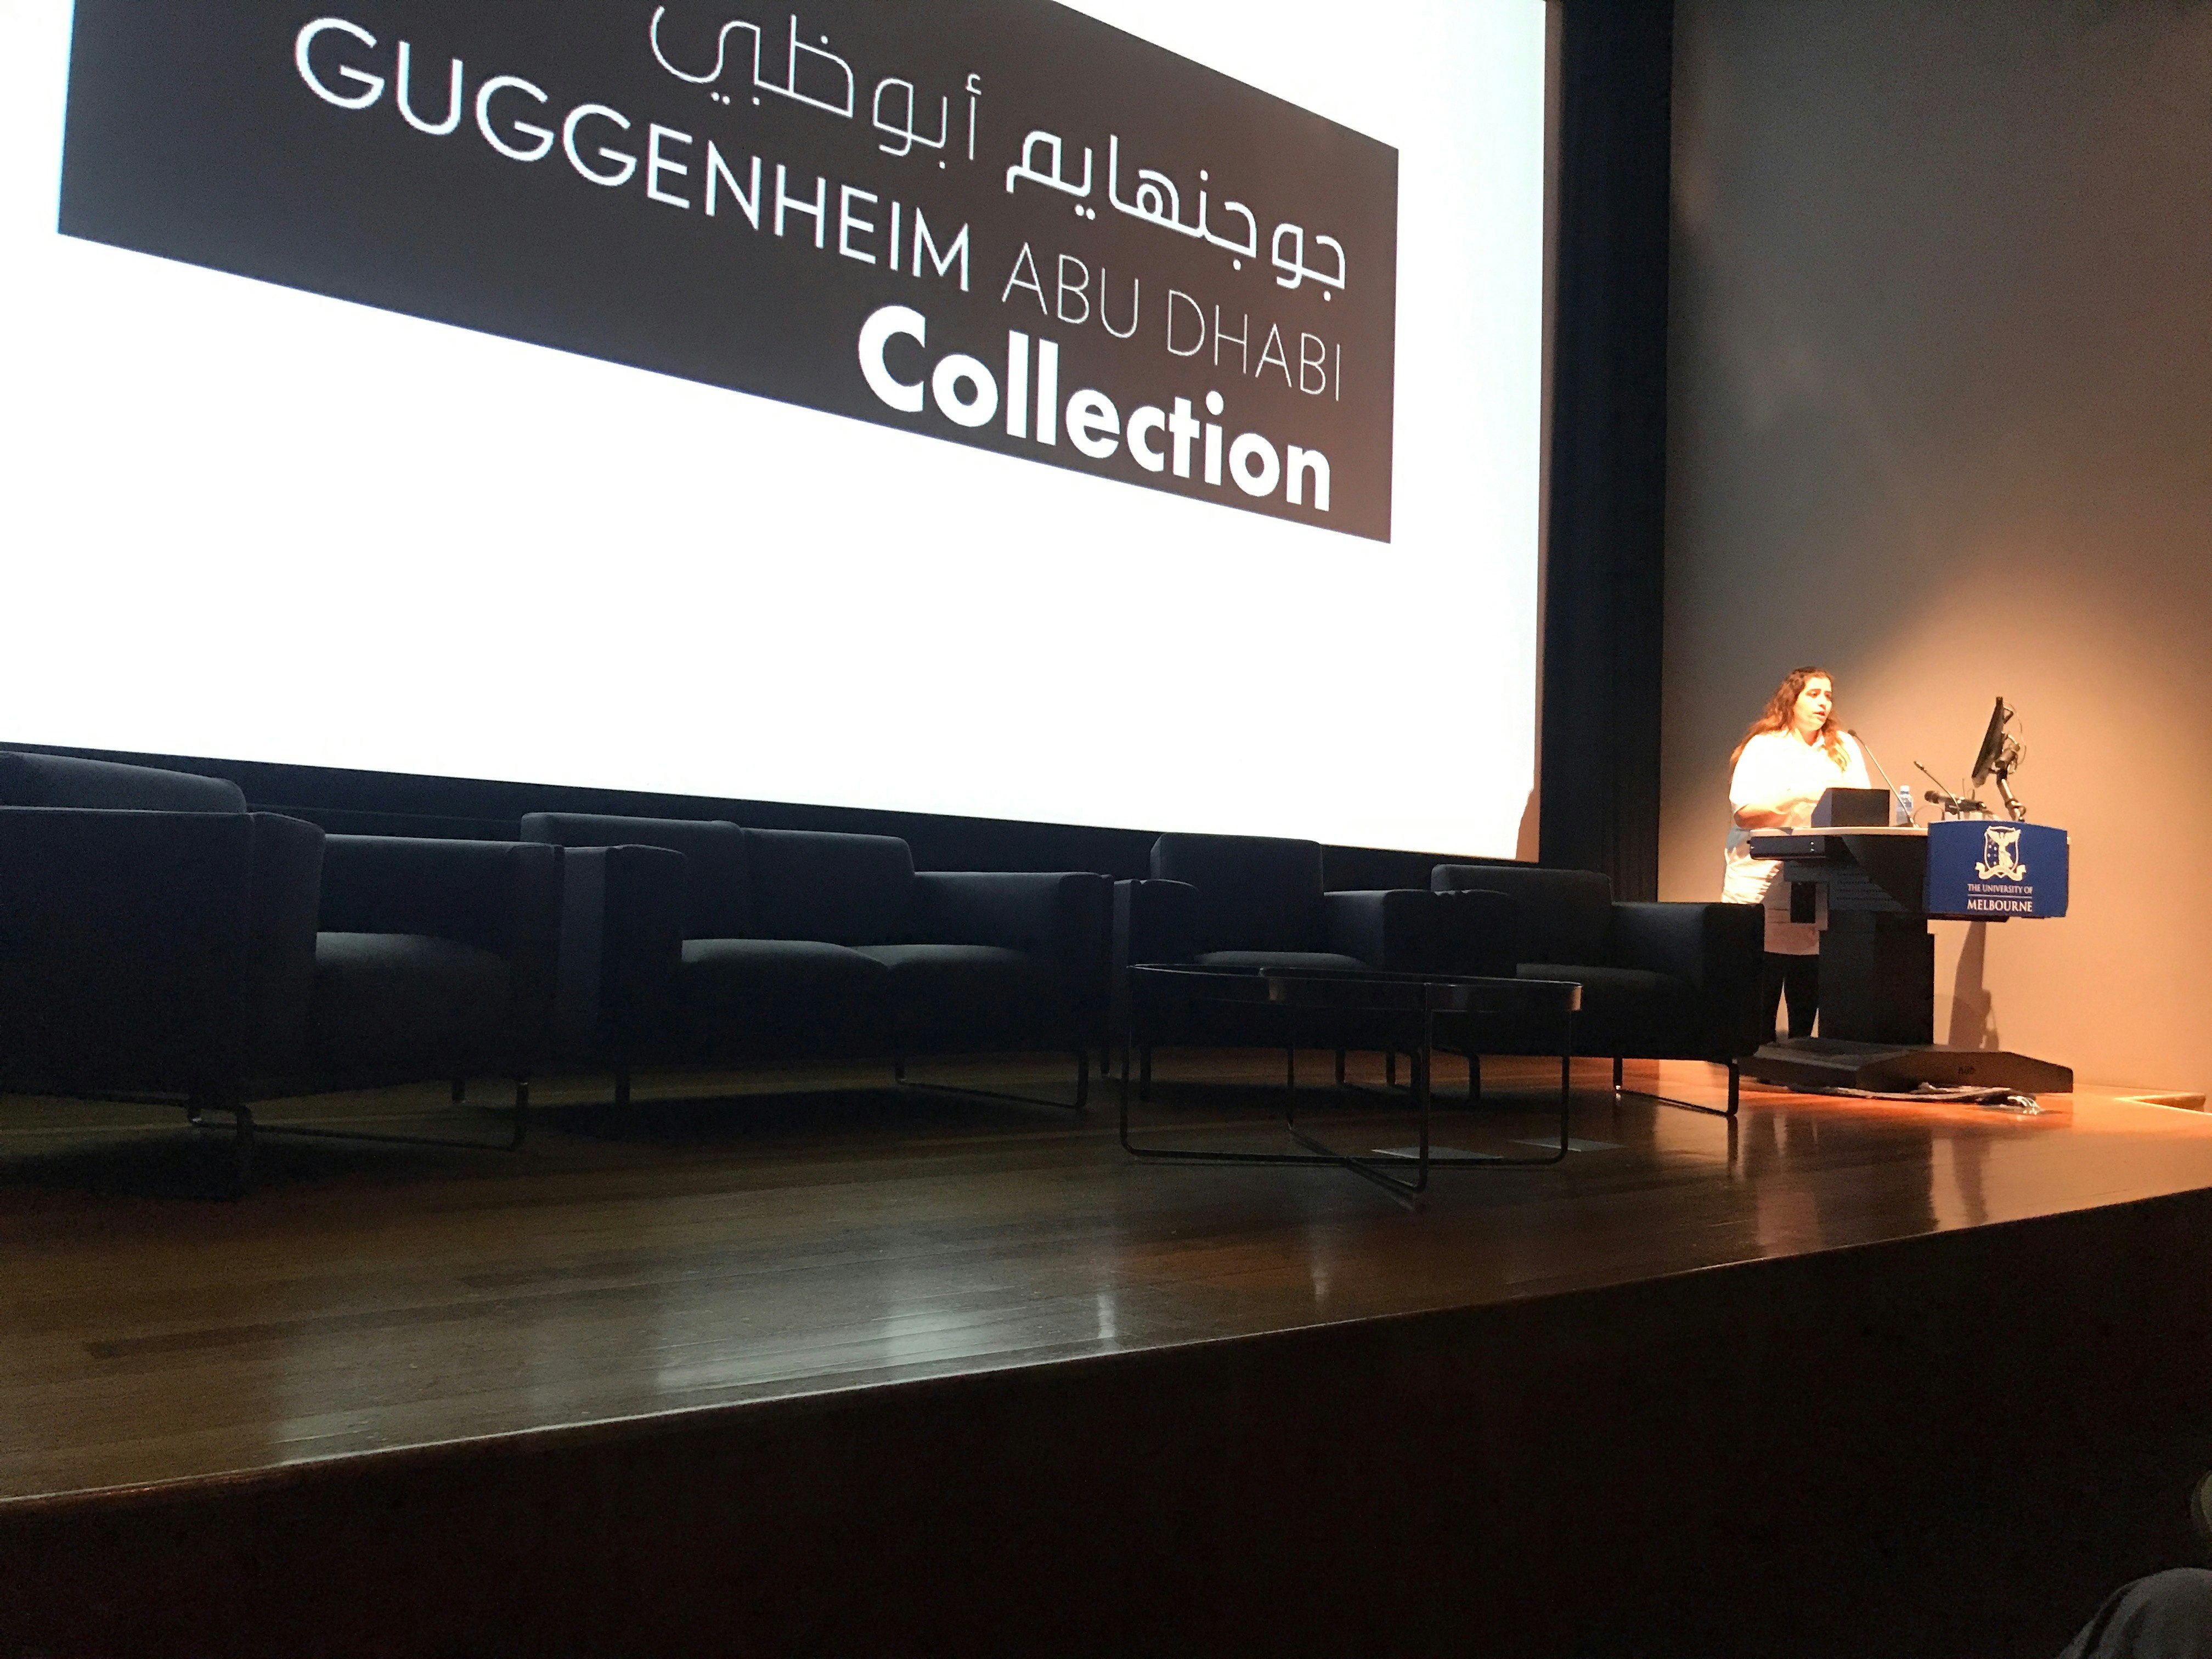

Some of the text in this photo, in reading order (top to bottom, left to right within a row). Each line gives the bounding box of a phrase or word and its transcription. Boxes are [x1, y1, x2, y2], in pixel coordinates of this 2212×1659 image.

[295, 16, 1341, 402] GUGGENHEIM ABU DHABI
[1006, 130, 1346, 302] جوجنهايم
[857, 305, 1331, 513] Collection
[1967, 883, 2033, 894] THE UNIVERSITY OF
[1967, 899, 2033, 912] MELBOURNE
